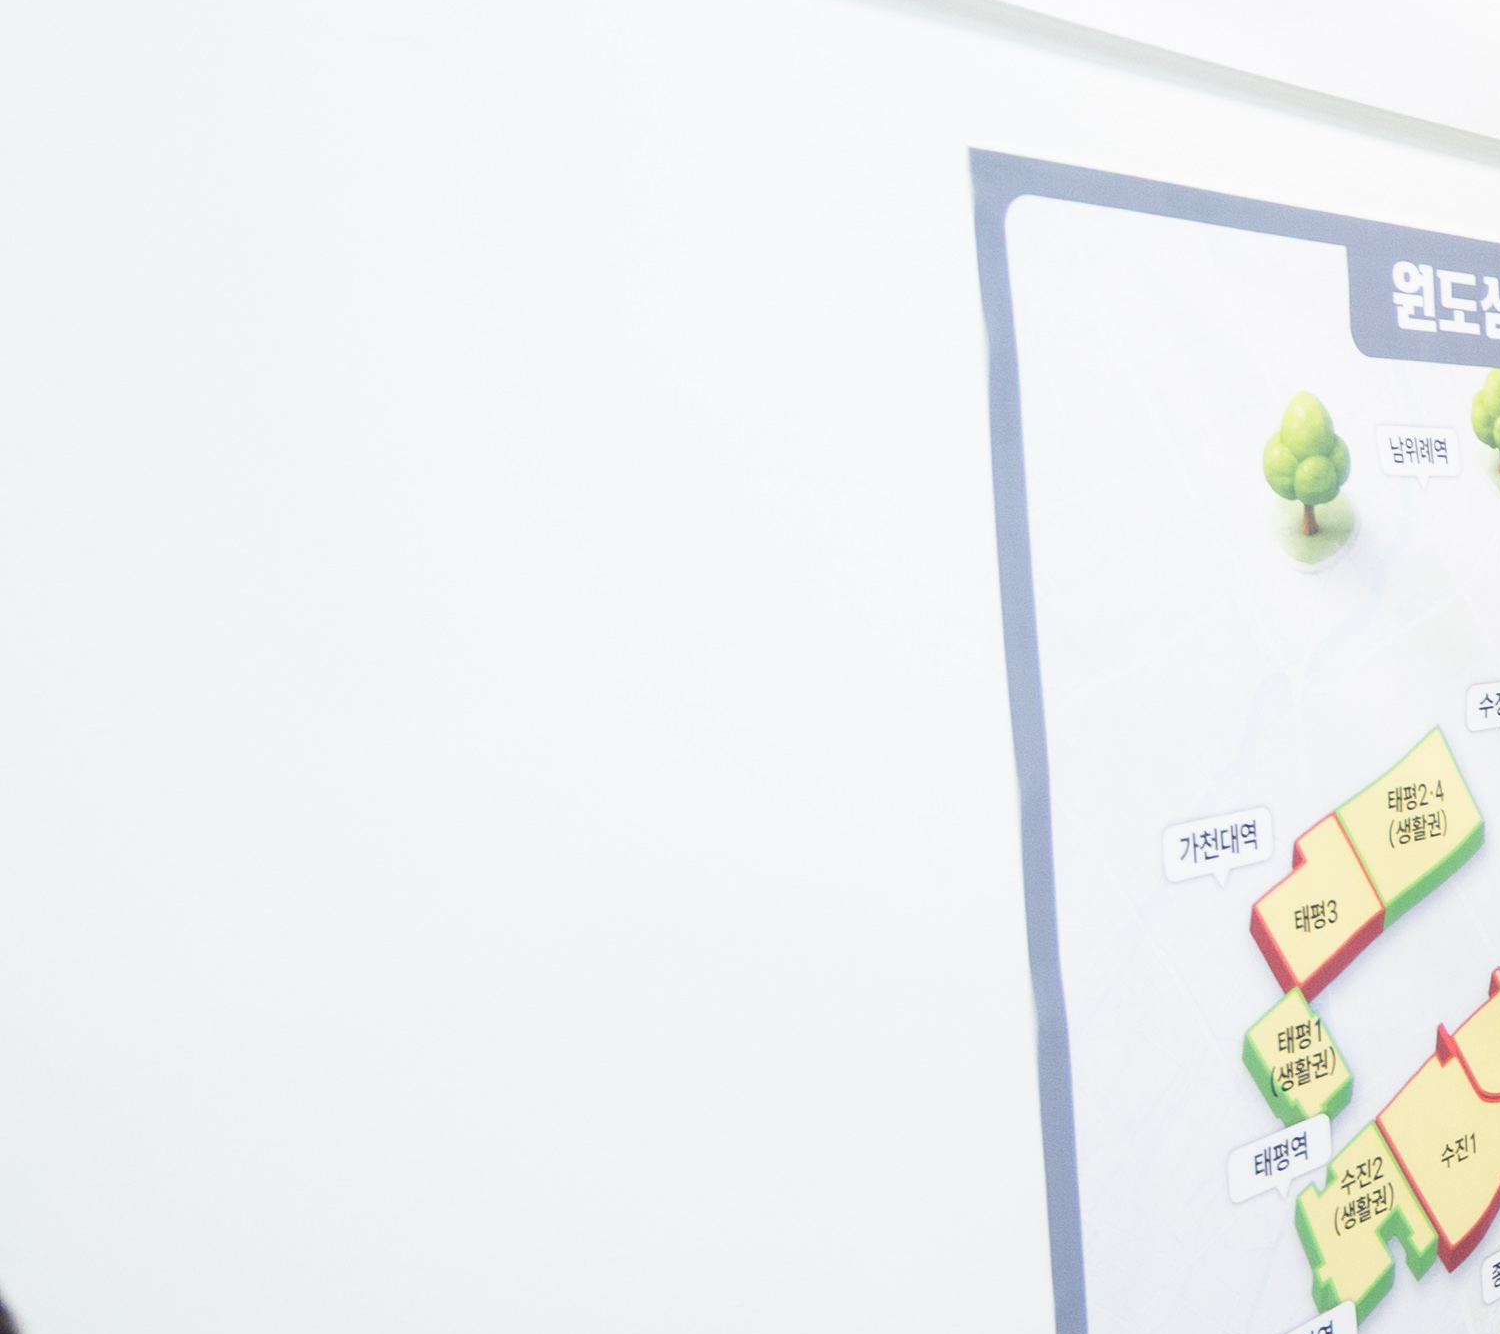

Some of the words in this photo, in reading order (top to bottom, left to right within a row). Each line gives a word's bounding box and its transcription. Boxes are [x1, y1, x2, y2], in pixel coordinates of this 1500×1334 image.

[1389, 436, 1449, 465] 남위례역
[1179, 819, 1259, 864] 가천대역
[1388, 809, 1448, 849] (생활권)
[1294, 899, 1338, 933] 태평3
[1277, 1018, 1323, 1055] 태평1
[1270, 1046, 1336, 1098] (생활권)
[1253, 1131, 1309, 1177] 태평역
[1440, 1133, 1477, 1168] 수진1
[1340, 1156, 1384, 1196] 수진2
[1334, 1182, 1395, 1237] (생활권)
